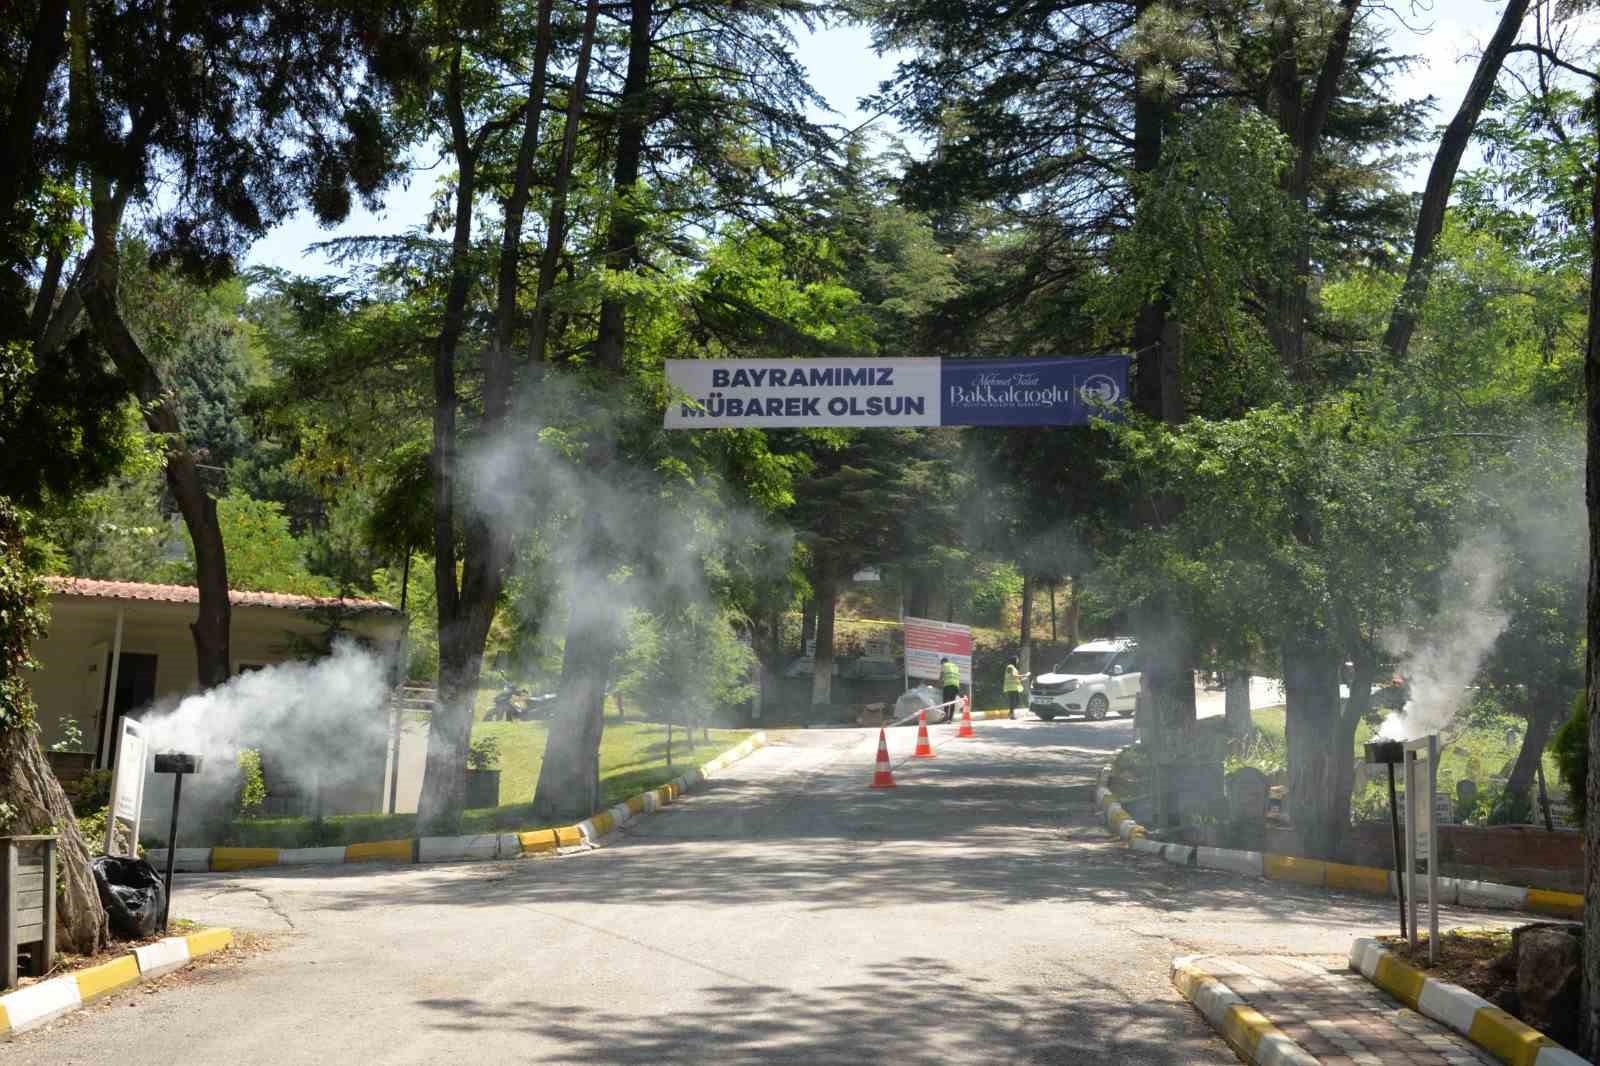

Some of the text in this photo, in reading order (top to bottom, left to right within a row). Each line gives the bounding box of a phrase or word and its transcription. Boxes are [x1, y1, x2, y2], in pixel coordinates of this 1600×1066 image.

[712, 367, 894, 388] BAYRAMIMIZ
[681, 391, 925, 418] MÜBAREK OLSUN
